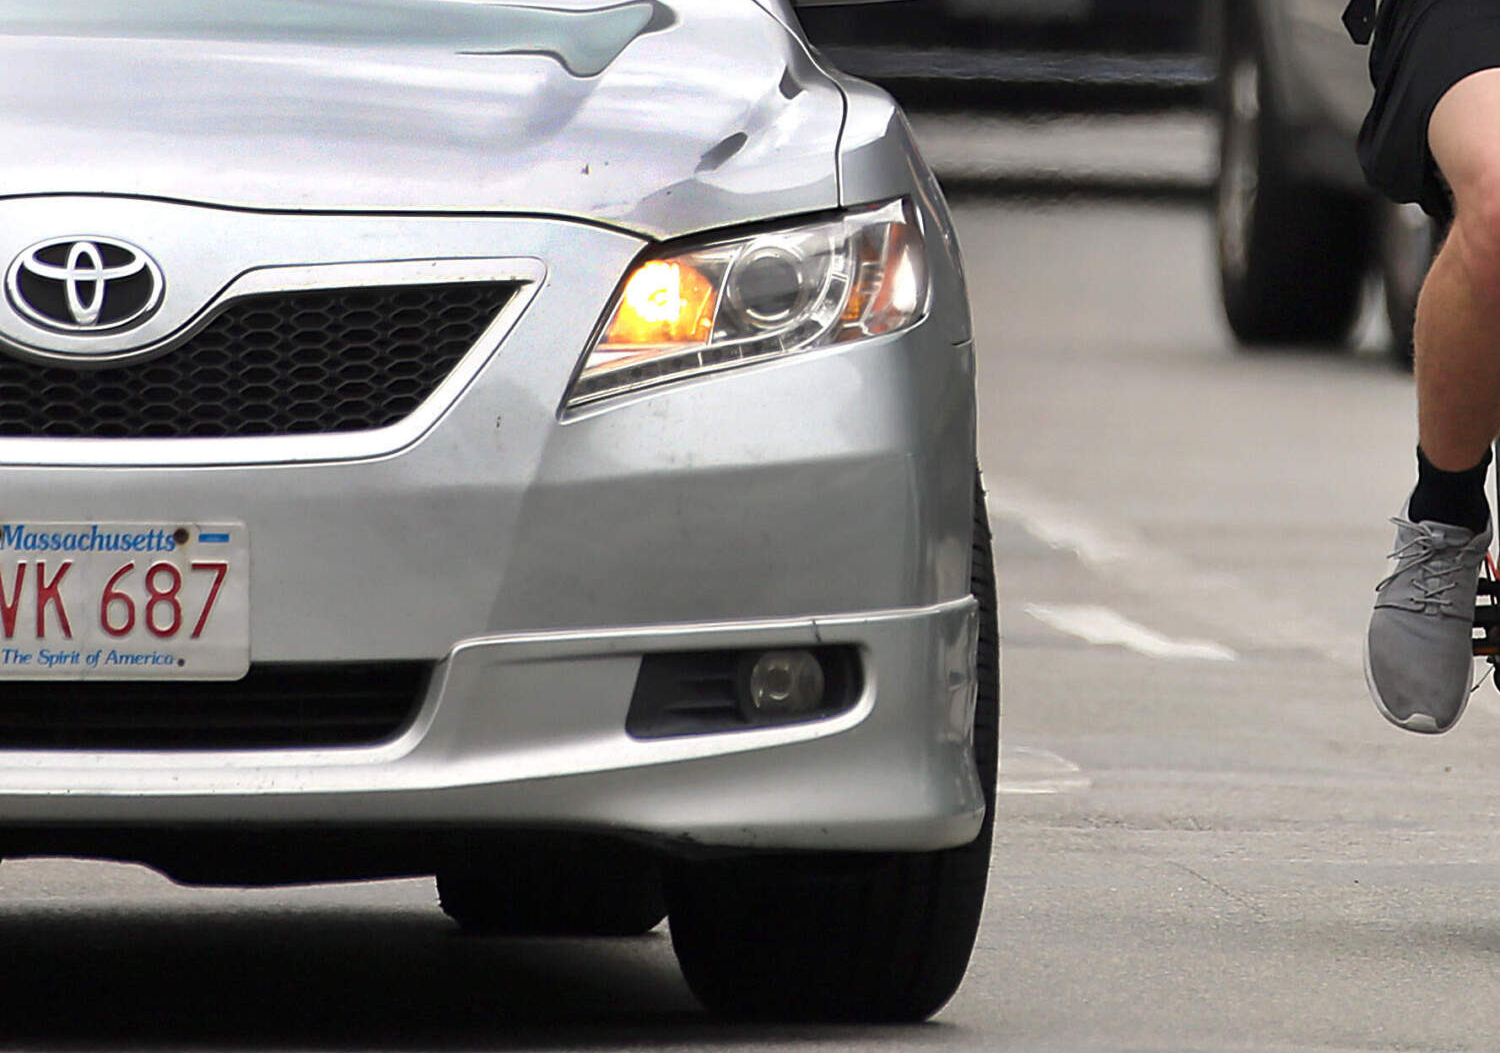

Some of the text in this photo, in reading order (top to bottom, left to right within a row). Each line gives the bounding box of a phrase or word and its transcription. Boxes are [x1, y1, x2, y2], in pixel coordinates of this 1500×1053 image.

[1, 524, 177, 551] Massachusetts
[101, 561, 228, 639] 687
[2, 649, 174, 667] The Spirit of America
